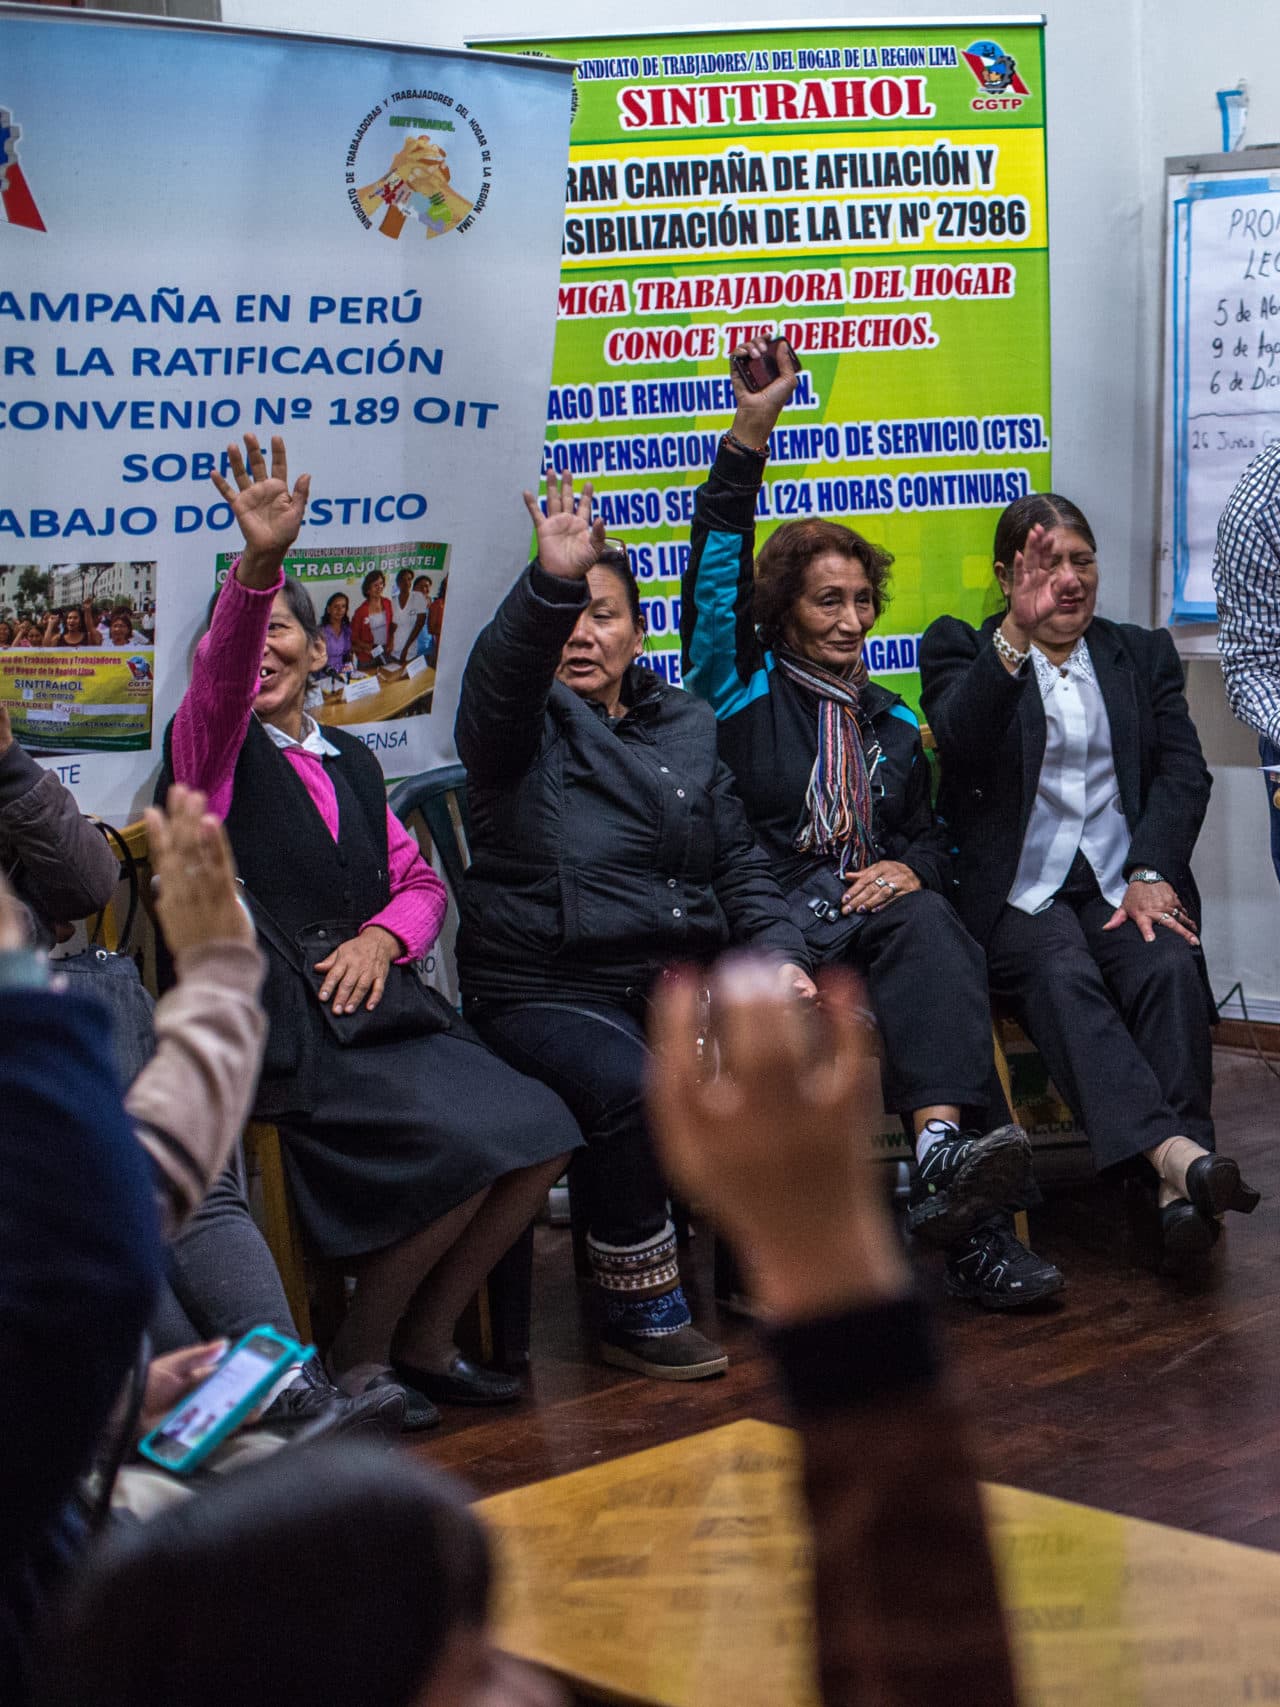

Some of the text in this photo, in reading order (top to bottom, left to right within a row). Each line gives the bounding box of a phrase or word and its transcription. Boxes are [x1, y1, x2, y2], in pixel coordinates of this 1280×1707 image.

[577, 58, 639, 79] SINDICATO
[643, 57, 659, 76] DE
[772, 51, 795, 70] DEL
[798, 49, 841, 69] HOGAR
[844, 49, 860, 68] DE
[863, 48, 878, 67] LA
[881, 47, 925, 67] REGION
[928, 47, 958, 66] LIMA
[383, 98, 389, 108] Y
[390, 89, 454, 107] TRABAJADORES
[455, 103, 470, 120] DEL
[621, 78, 932, 128] SINTTRAHOL
[971, 98, 1023, 111] CGTP
[346, 105, 383, 168] TRABAJADORAS
[468, 117, 487, 148] HOGAR
[481, 150, 492, 162] DE
[482, 166, 492, 178] LA
[624, 151, 768, 199] CAMPAÑA
[772, 155, 810, 192] DE
[814, 144, 970, 189] AFILIACIÓN
[975, 149, 994, 185] Y
[345, 171, 356, 184] DE
[347, 187, 373, 231] SINDICATO
[455, 214, 476, 234] LIMA
[562, 204, 759, 255] SIBILIZACIÓN
[764, 207, 801, 244] DE
[806, 205, 842, 242] LA
[846, 203, 892, 240] LEY
[936, 199, 1027, 238] 27986
[637, 272, 844, 311] TRABAJADORA
[853, 269, 905, 299] DEL
[913, 266, 1012, 297] HOGAR
[236, 294, 291, 323] EN
[309, 289, 422, 324] PERÚ
[1214, 298, 1229, 327] 5
[1235, 298, 1252, 323] de
[608, 328, 716, 361] CONOCE
[783, 316, 936, 351] DERECHOS.
[1211, 337, 1224, 359] 9
[1233, 336, 1249, 358] de
[56, 347, 115, 377] LA
[132, 338, 444, 376] RATIFICACIÓN
[1210, 369, 1221, 395] 6
[1229, 371, 1244, 392] de
[0, 398, 242, 431] ONVENIO
[328, 396, 400, 426] 189
[413, 397, 499, 429] OIT
[598, 384, 628, 417] DE
[541, 434, 717, 476] COMPENSACION
[844, 424, 874, 456] DE
[878, 419, 979, 455] SERVICIO
[982, 417, 1048, 451] (CTS).
[774, 483, 814, 514] (24
[817, 477, 894, 513] HORAS
[174, 493, 427, 534] DOSTICO
[292, 555, 436, 577] TRABAJO DECENTE!
[14, 679, 83, 691] SINTTRAHOL
